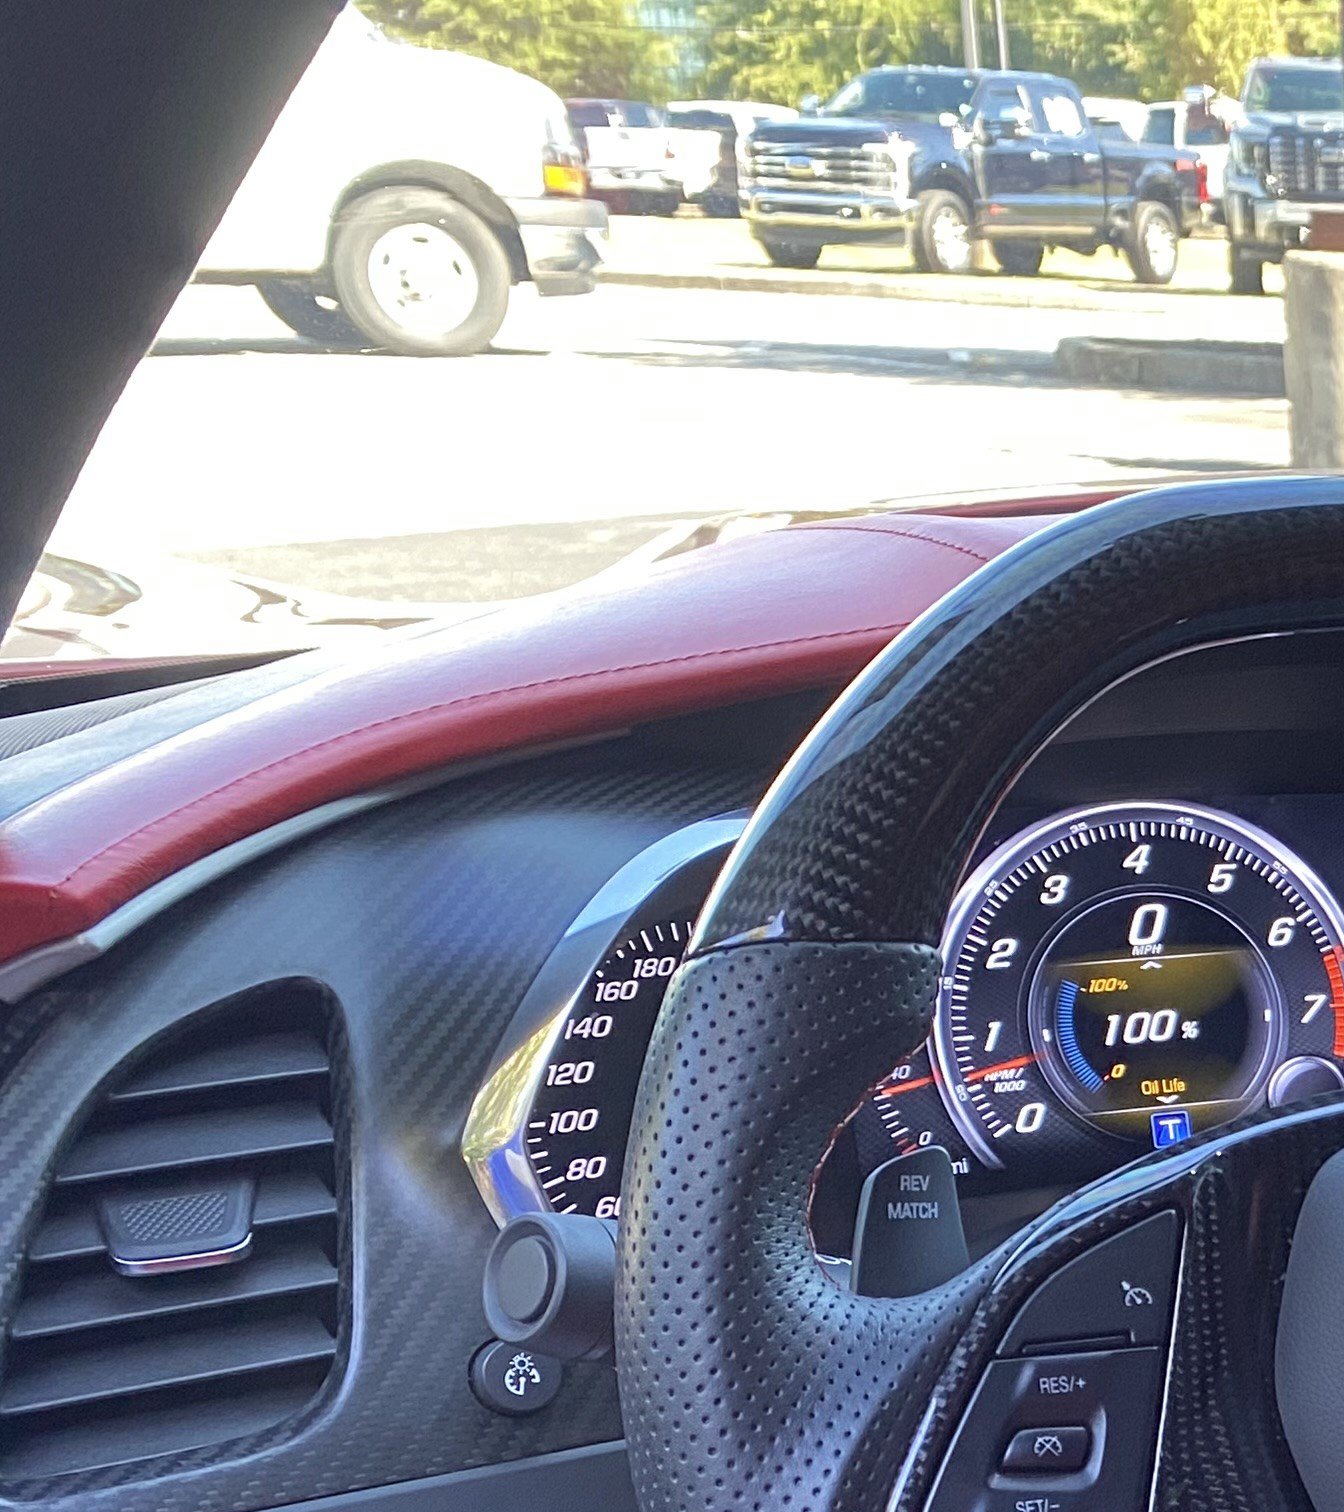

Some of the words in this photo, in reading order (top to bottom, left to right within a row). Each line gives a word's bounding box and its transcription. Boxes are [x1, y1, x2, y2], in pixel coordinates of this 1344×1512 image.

[1069, 821, 1088, 834] 35
[1176, 816, 1194, 826] 45
[1123, 845, 1151, 874] 4
[1272, 860, 1288, 875] 55
[1040, 874, 1069, 904] 3
[1207, 863, 1237, 893] 5
[1129, 903, 1168, 946] 0
[1267, 917, 1296, 947] 6
[986, 938, 1018, 969] 2
[1132, 943, 1162, 955] MPH
[633, 957, 677, 979] 180
[595, 980, 639, 1002] 160
[1088, 977, 1129, 993] 100%
[1300, 994, 1327, 1024] 7
[565, 1016, 613, 1039] 140
[984, 1021, 1003, 1052] 1
[1105, 1010, 1178, 1047] 100
[1181, 1021, 1201, 1040] %
[546, 1062, 595, 1085] 120
[1110, 1063, 1127, 1079] 0
[993, 1079, 1027, 1094] 1000
[1141, 1080, 1160, 1096] Oil
[1162, 1078, 1186, 1094] Life
[549, 1109, 599, 1134] 100
[1015, 1102, 1047, 1134] 0
[918, 1131, 931, 1146] 0
[565, 1156, 607, 1181] 80
[900, 1175, 930, 1193] REV
[887, 1202, 939, 1221] MATCH
